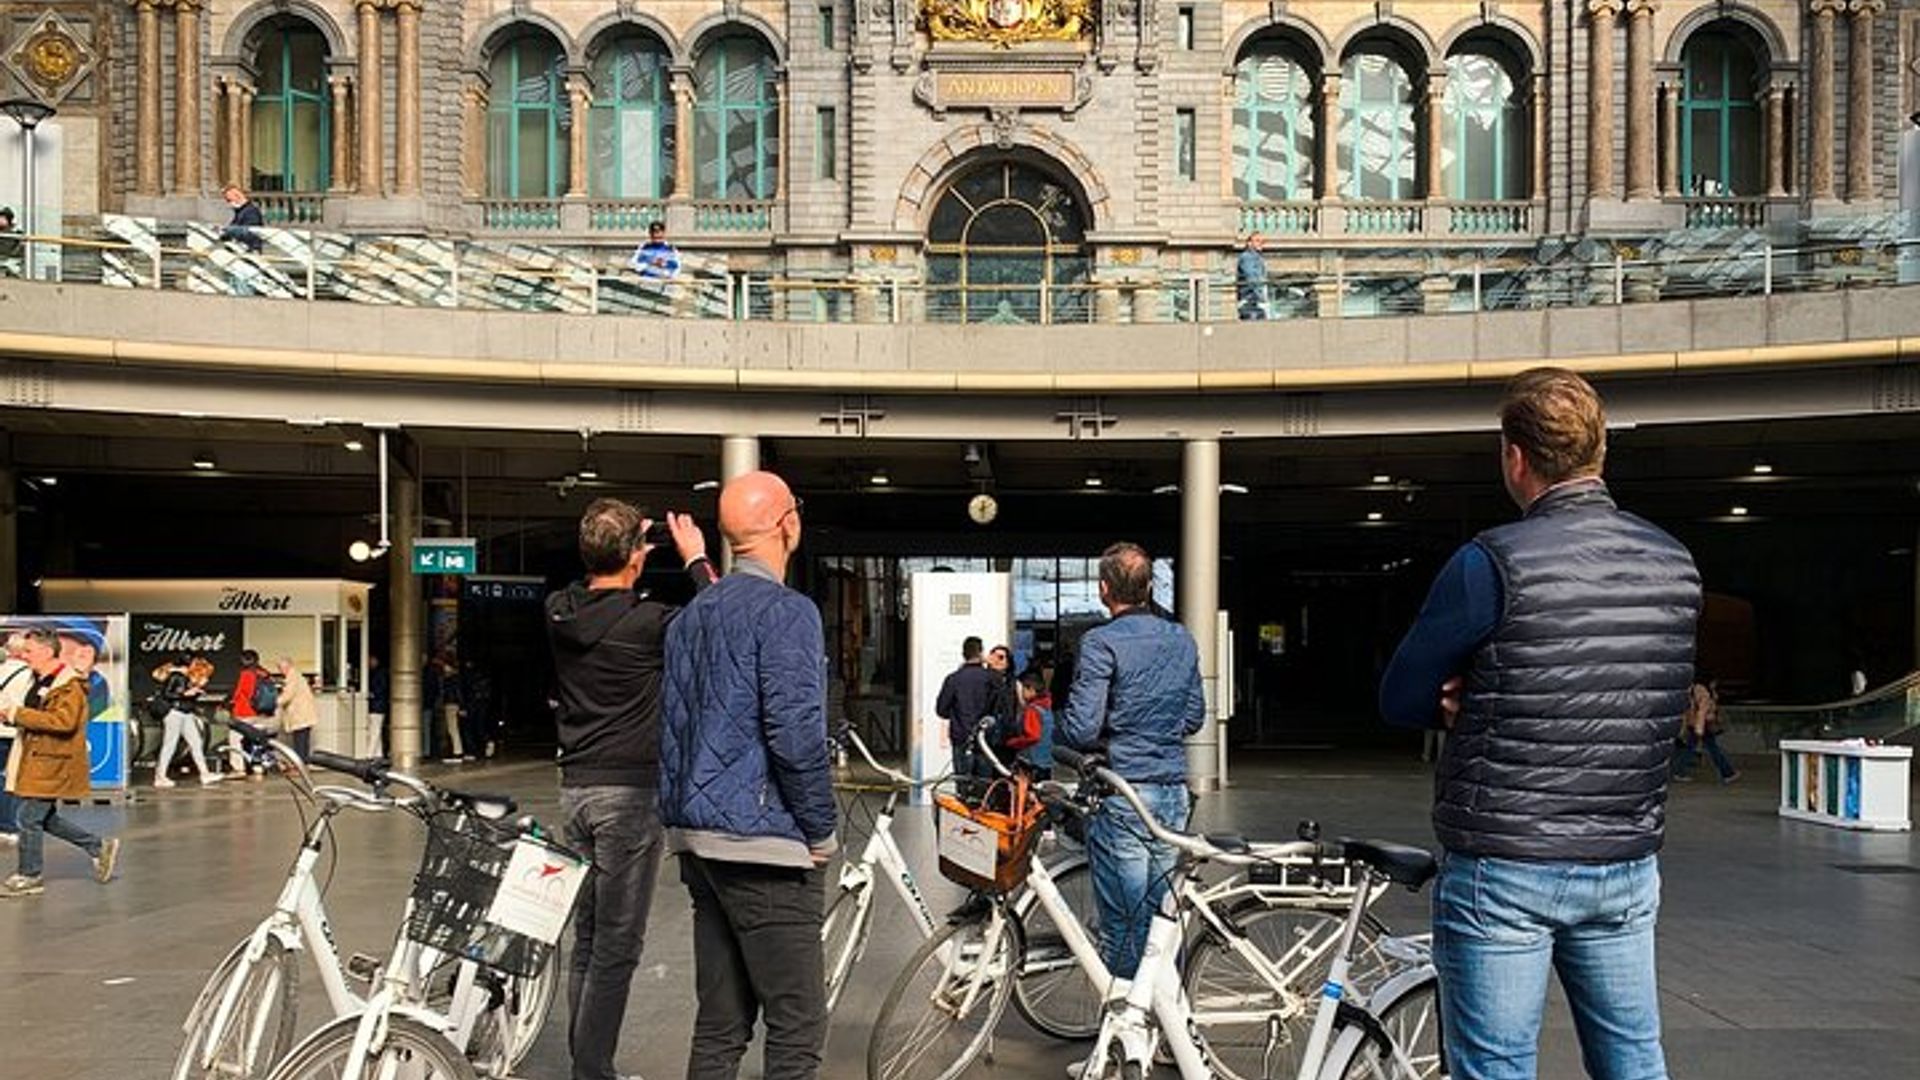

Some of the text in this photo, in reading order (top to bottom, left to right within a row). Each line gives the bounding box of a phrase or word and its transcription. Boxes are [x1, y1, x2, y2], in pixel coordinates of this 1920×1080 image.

[947, 77, 1060, 95] ANTWERPEN
[218, 590, 291, 610] Albert
[140, 628, 226, 651] Albert
